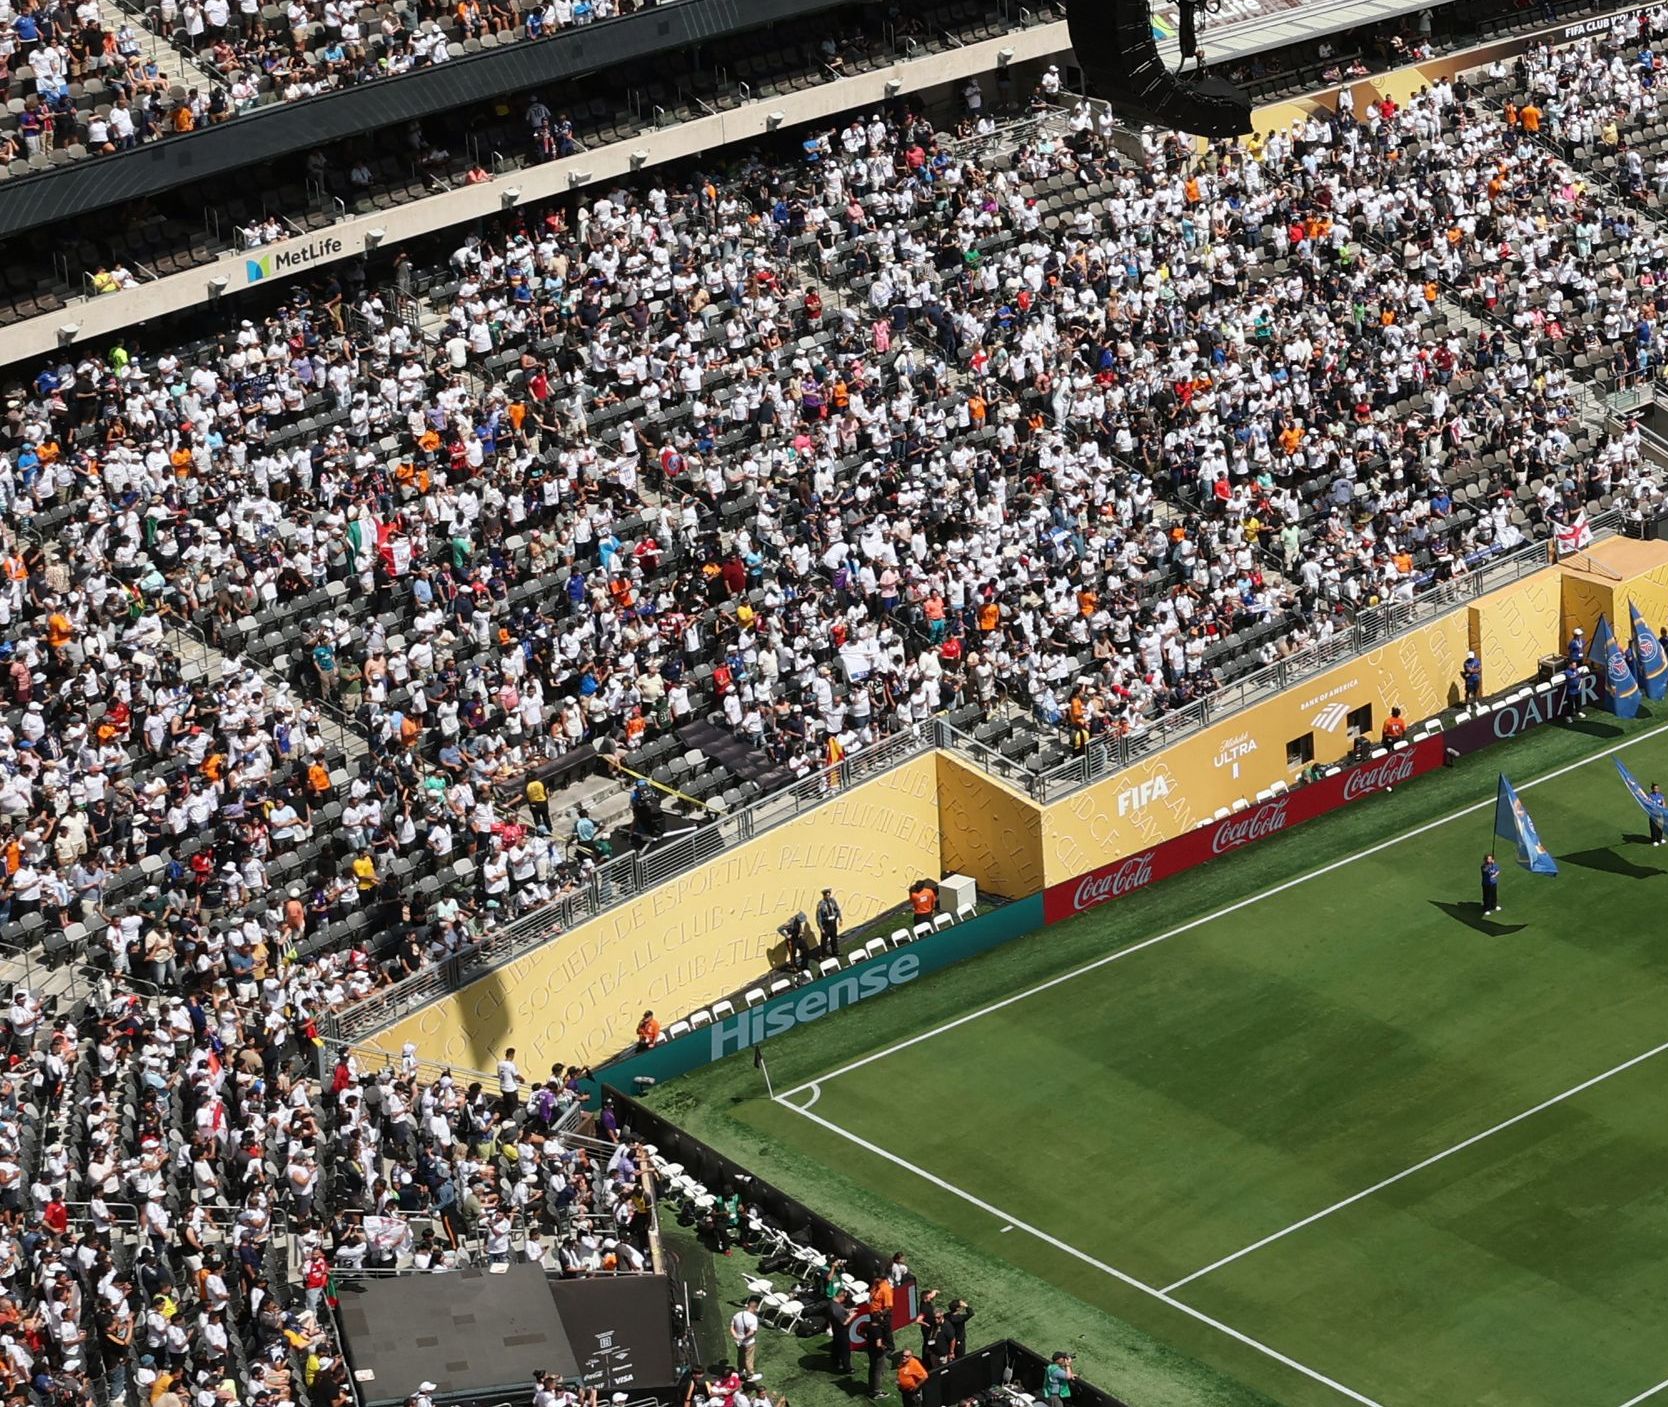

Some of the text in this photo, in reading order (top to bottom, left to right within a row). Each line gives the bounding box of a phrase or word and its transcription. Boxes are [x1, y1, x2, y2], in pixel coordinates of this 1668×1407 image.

[1564, 17, 1610, 39] FIFA CLUB
[275, 237, 342, 272] MetLife
[1328, 679, 1361, 700] AMERICA
[1212, 738, 1259, 769] ULTRA
[1344, 748, 1417, 801] Coca-Cola
[1117, 773, 1173, 817] FIFA
[1211, 797, 1290, 854] Coca-Cola
[1073, 851, 1155, 912] Coca-Cola
[710, 953, 920, 1062] Hisense
[614, 1373, 634, 1386] VISA
